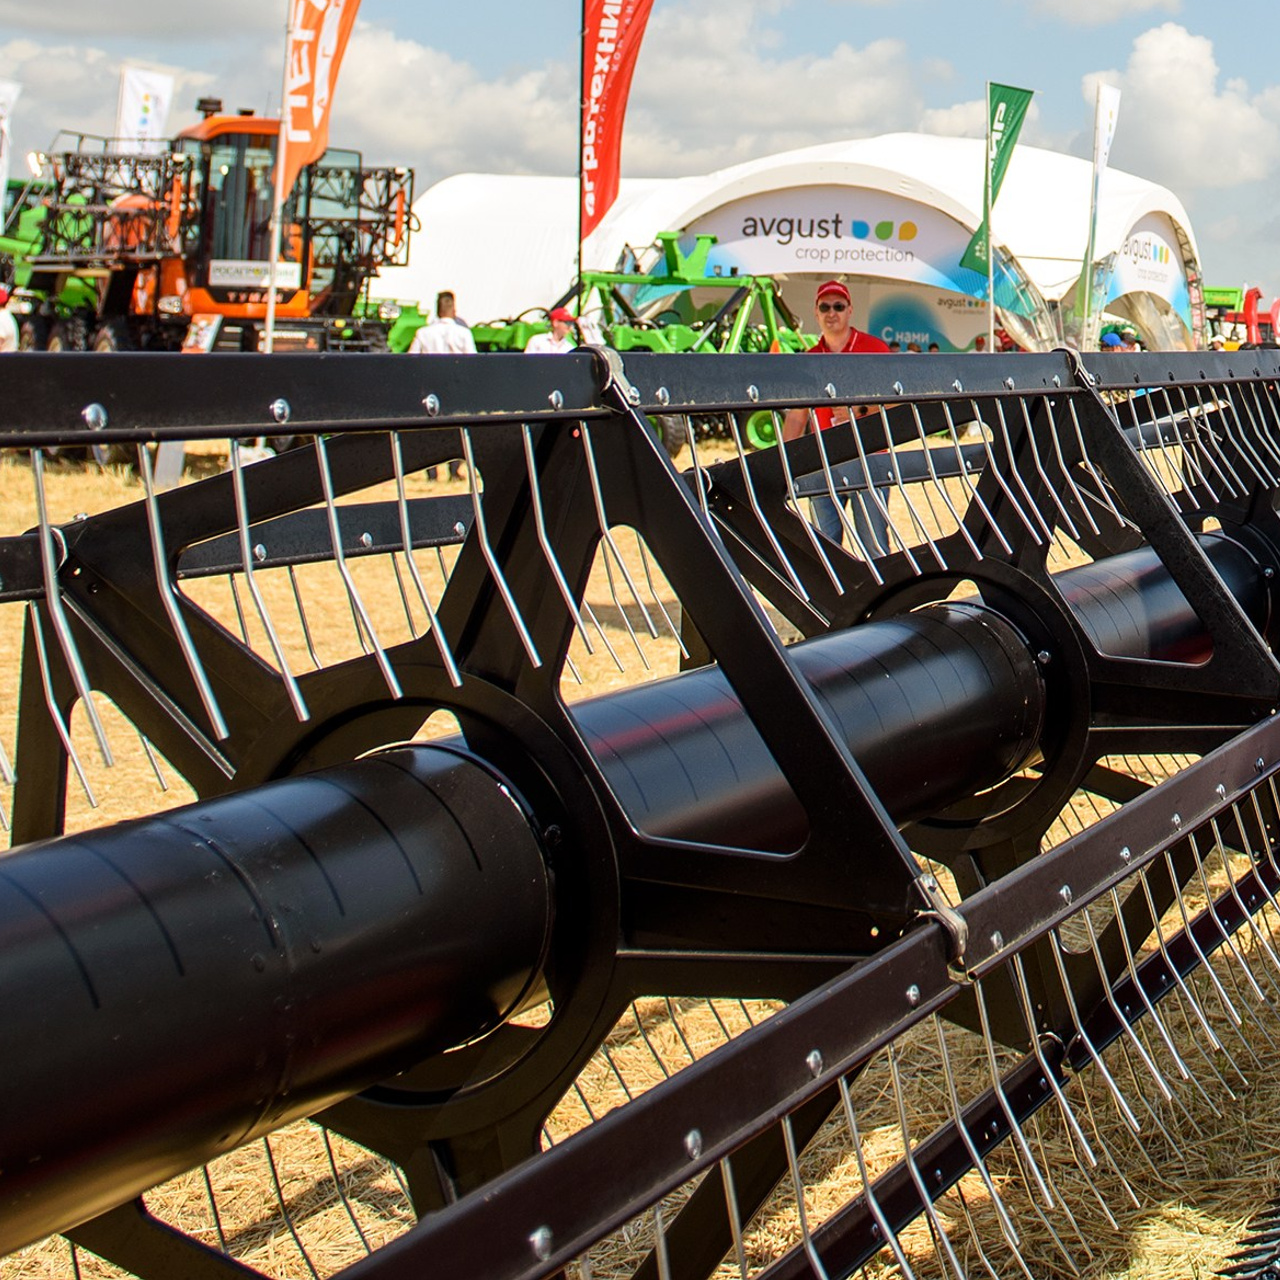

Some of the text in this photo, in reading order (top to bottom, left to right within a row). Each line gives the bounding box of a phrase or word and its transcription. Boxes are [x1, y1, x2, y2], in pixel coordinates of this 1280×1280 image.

[742, 213, 842, 245] avgust
[795, 247, 914, 263] crop protection
